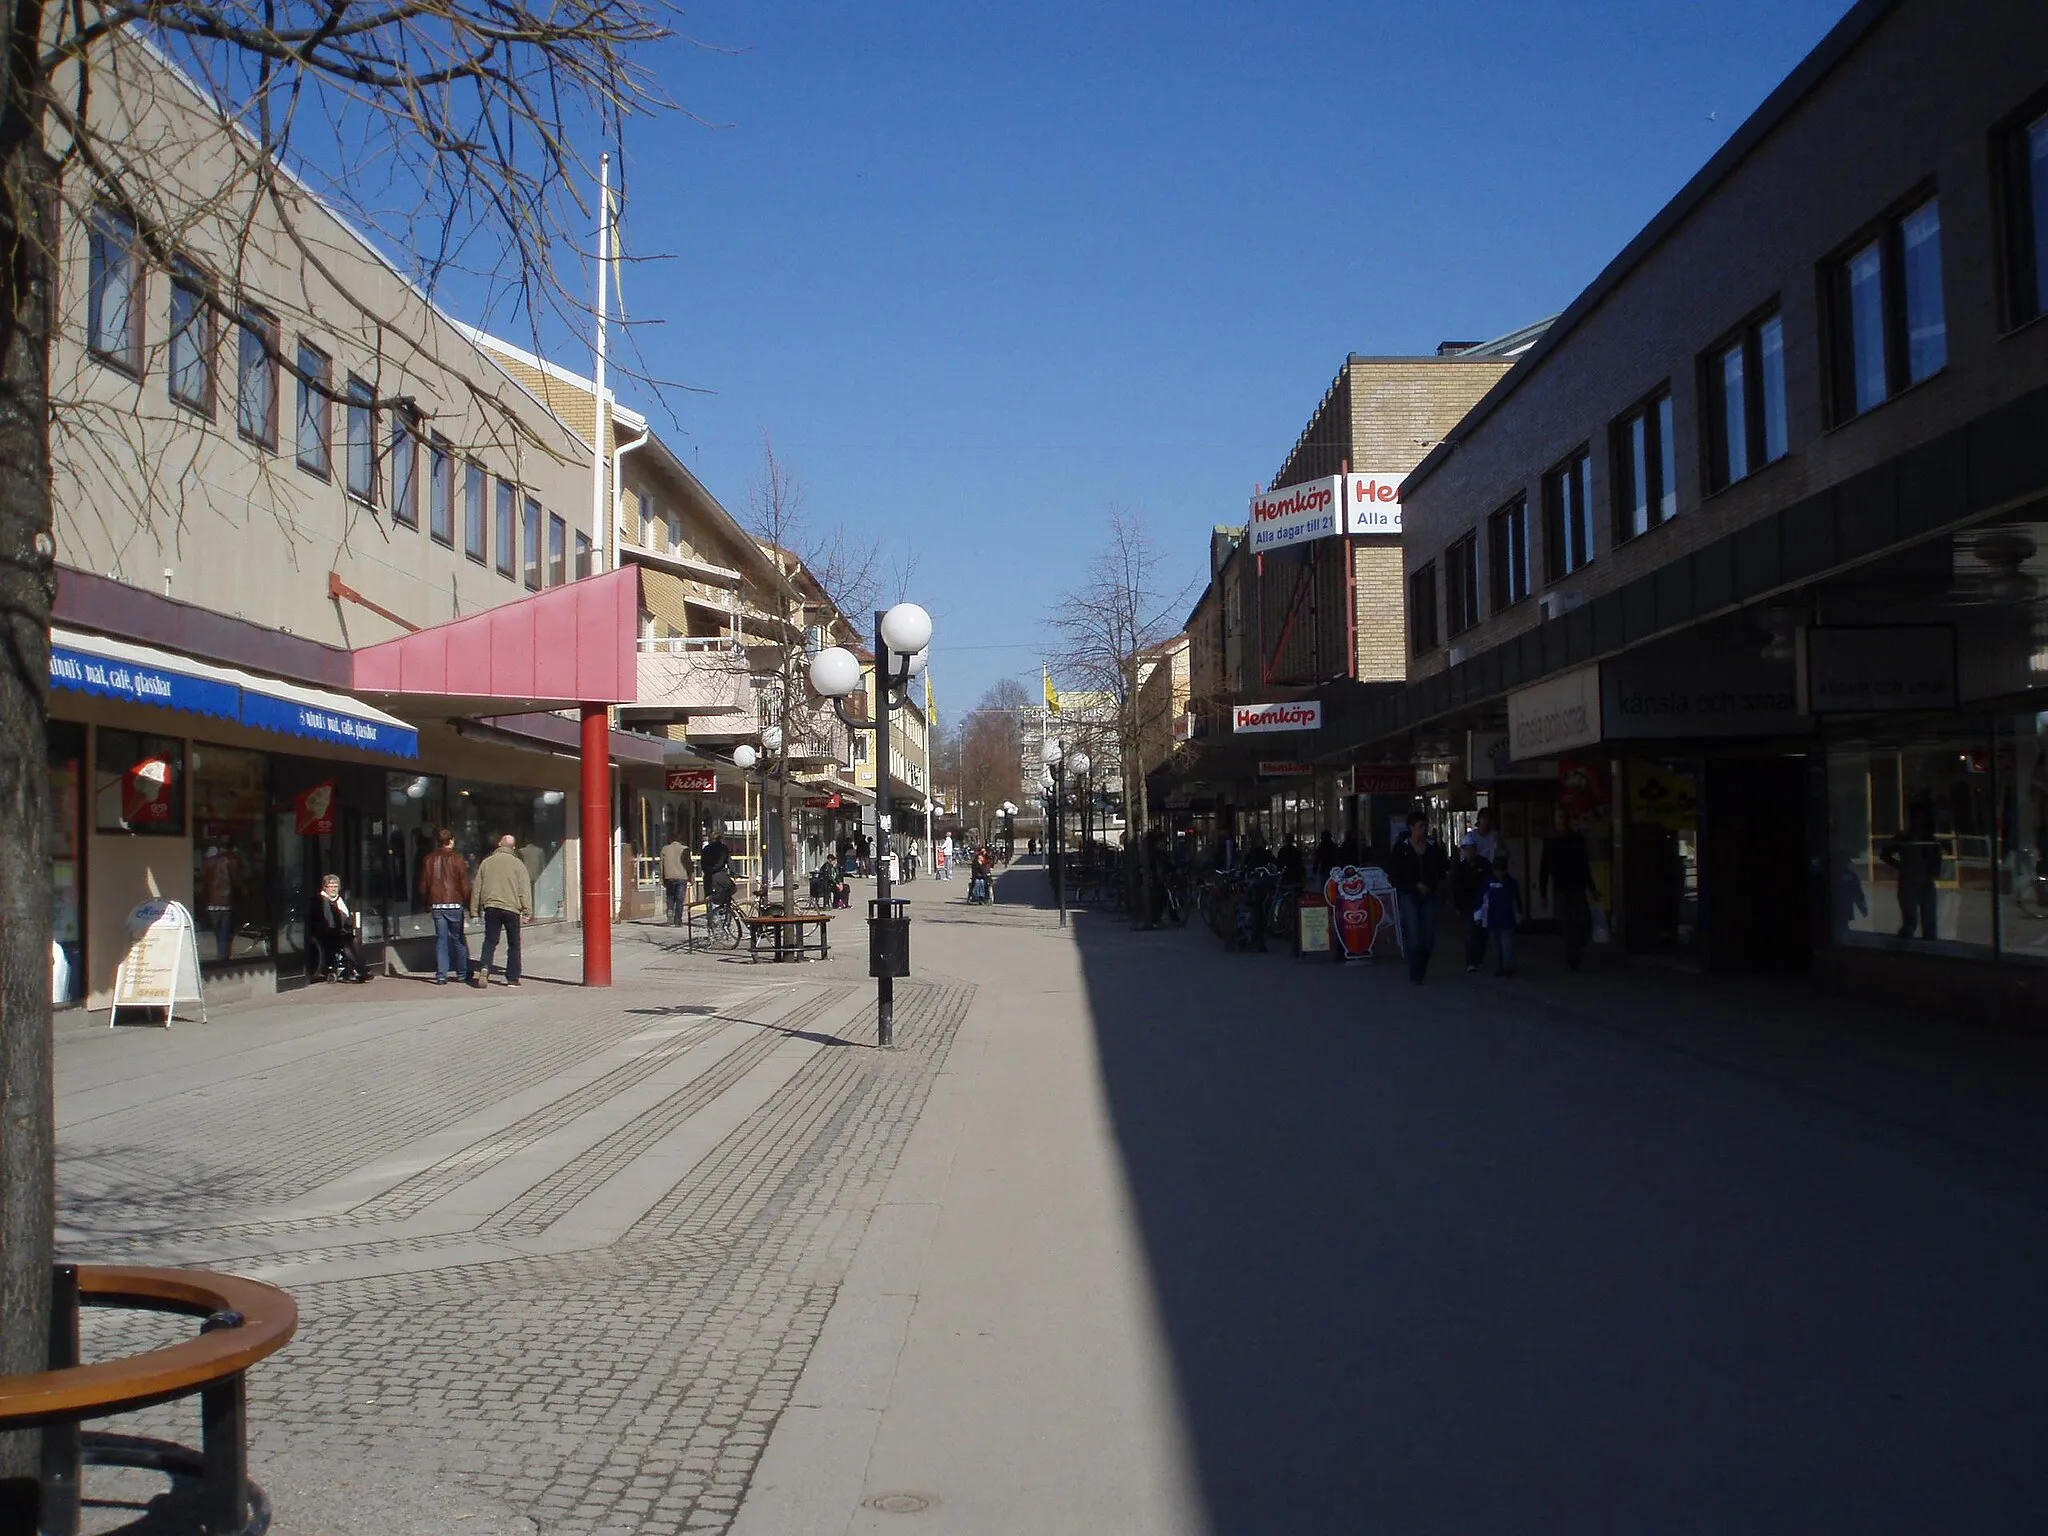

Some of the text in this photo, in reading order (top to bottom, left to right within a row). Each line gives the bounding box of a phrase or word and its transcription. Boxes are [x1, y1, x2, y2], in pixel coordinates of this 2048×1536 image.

[1356, 479, 1399, 503] He
[1254, 486, 1332, 523] Hemköp
[1255, 515, 1334, 545] Alla dagar till 21
[1357, 512, 1388, 525] Alla
[134, 671, 171, 697] glassbar
[1617, 679, 1690, 715] känsla
[1695, 686, 1736, 714] och
[1237, 706, 1316, 727] Hemköp
